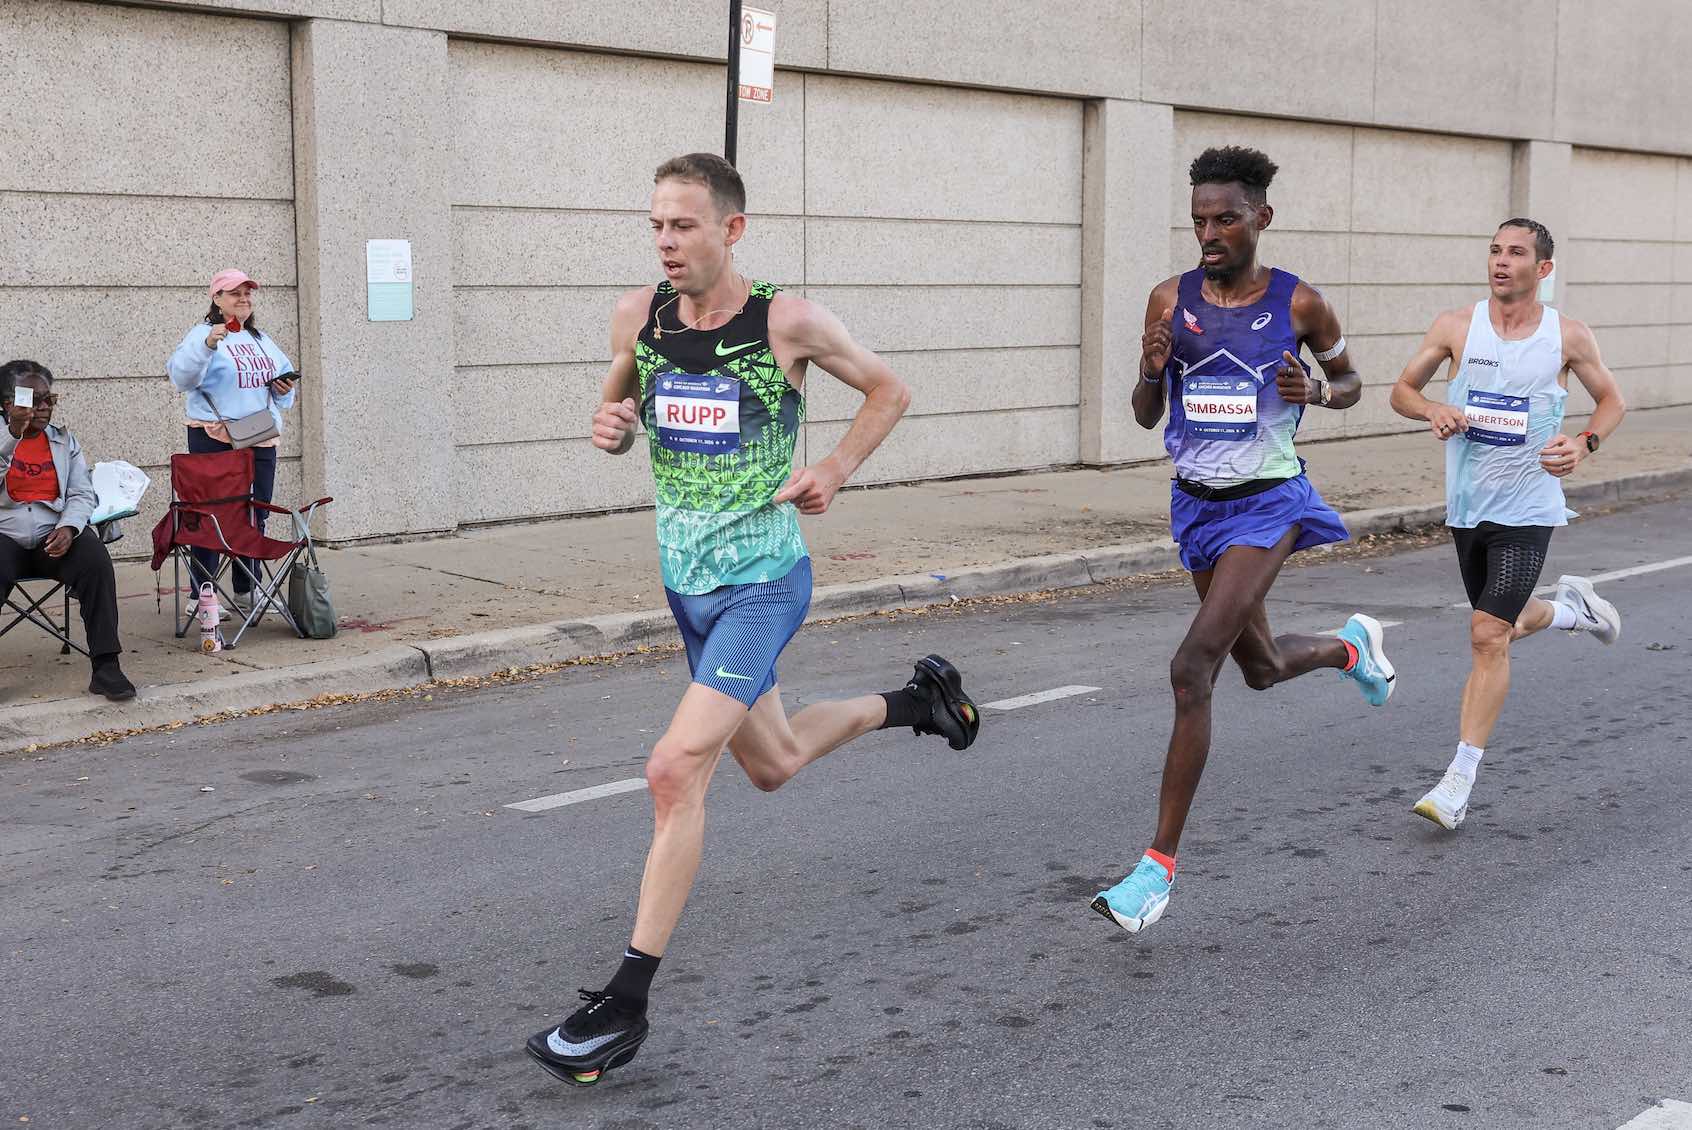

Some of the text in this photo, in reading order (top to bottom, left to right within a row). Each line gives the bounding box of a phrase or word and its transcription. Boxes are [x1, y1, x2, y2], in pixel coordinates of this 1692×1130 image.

[738, 86, 769, 101] TOW ZONE
[226, 343, 255, 356] LOVE
[234, 356, 276, 372] IS YOUR
[1468, 357, 1500, 368] BROOKS
[237, 370, 272, 388] LEGAC
[667, 403, 726, 426] RUPP
[1186, 402, 1254, 415] SIMBASSA
[1466, 413, 1525, 427] ALBERTSON
